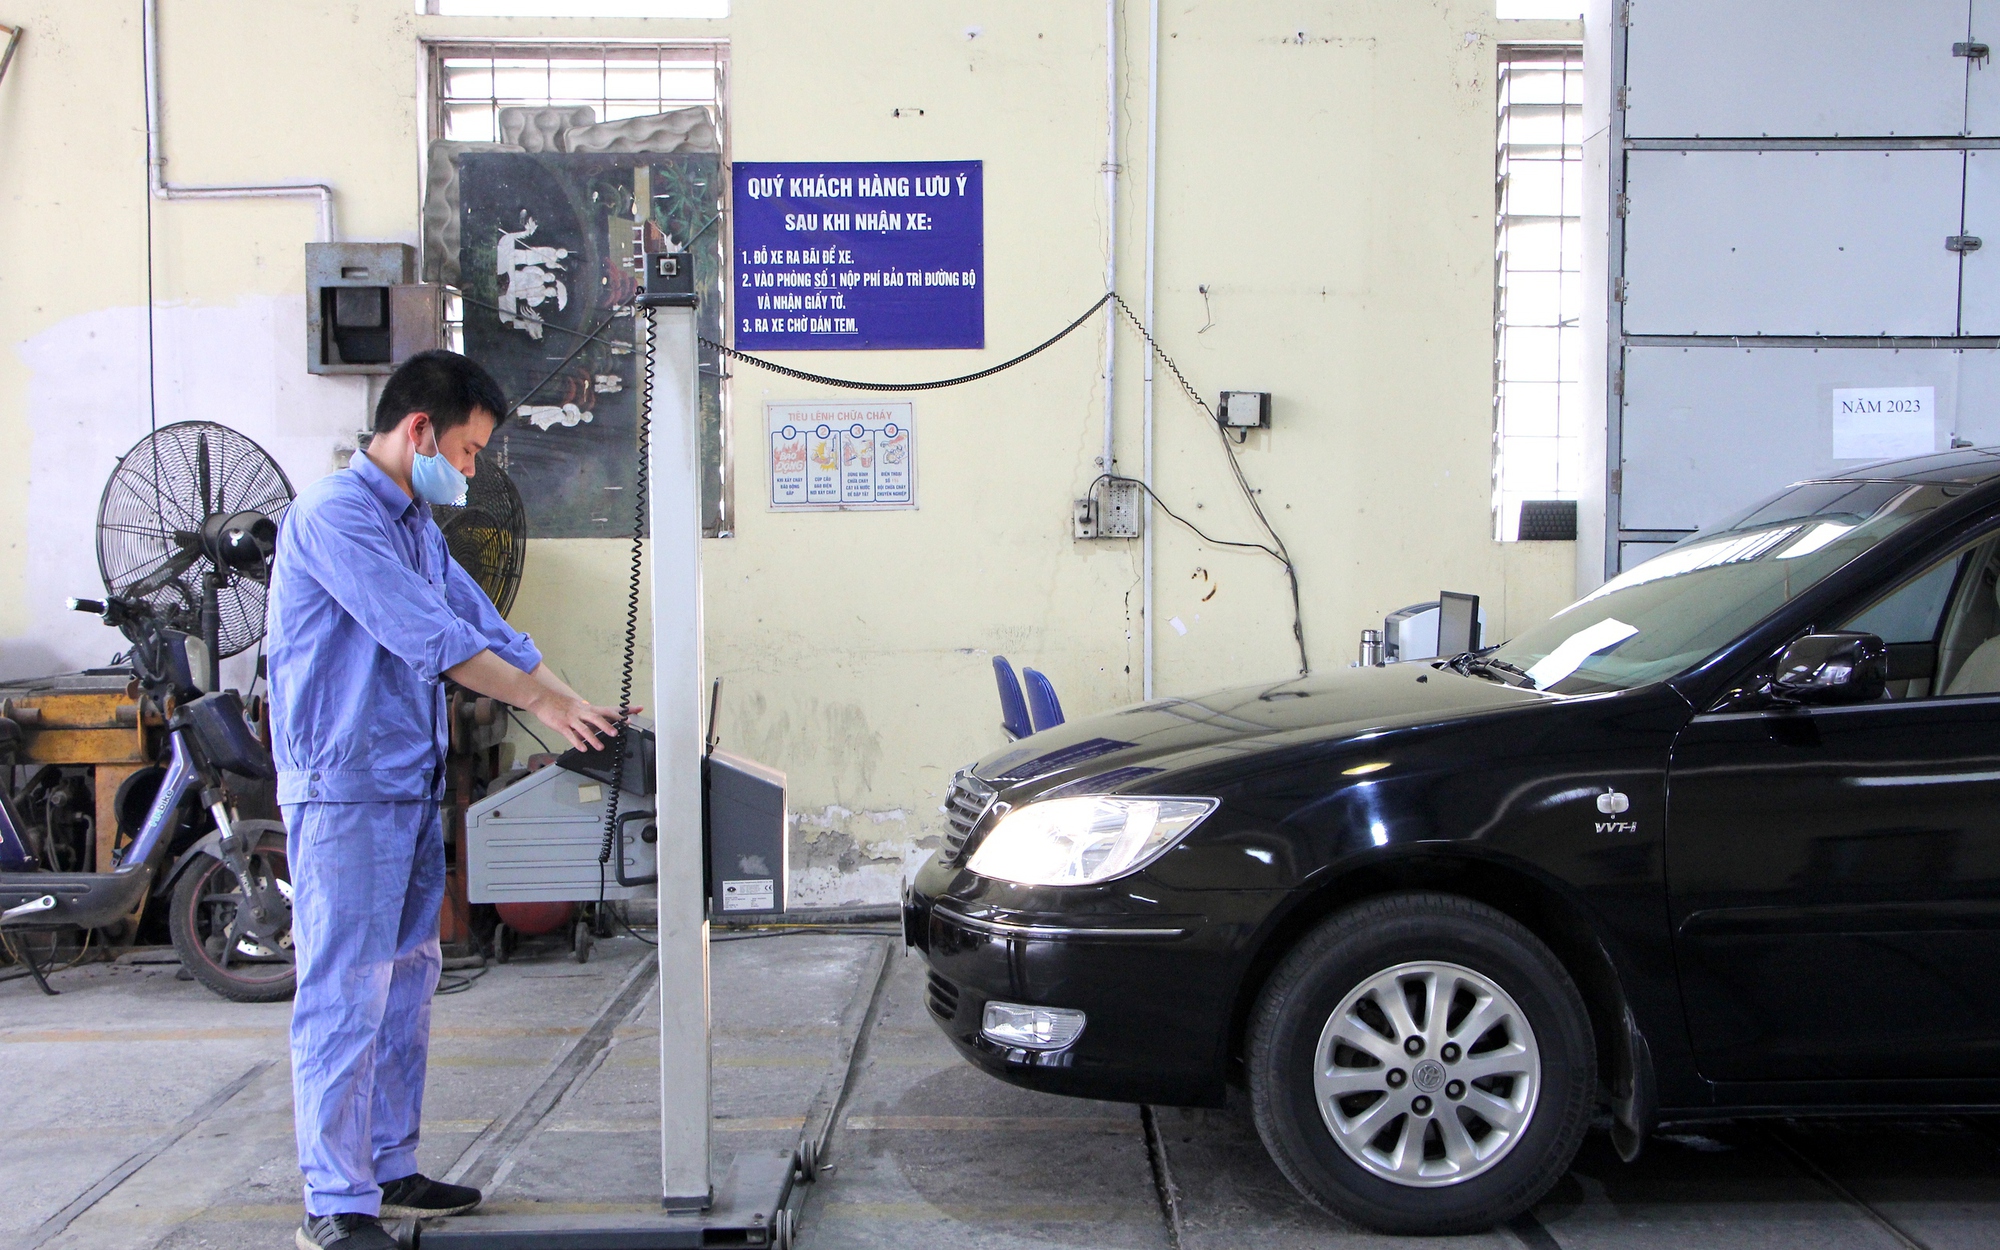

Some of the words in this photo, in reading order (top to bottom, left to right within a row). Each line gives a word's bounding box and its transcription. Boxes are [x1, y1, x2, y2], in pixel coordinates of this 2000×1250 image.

[748, 174, 784, 199] QUÝ
[790, 174, 852, 197] KHÁCH
[858, 174, 909, 197] HÀNG
[915, 175, 950, 197] LƯU
[955, 173, 967, 196] Ý
[785, 213, 817, 231] SAU
[823, 213, 850, 231] KHI
[855, 210, 901, 234] NHẬN
[906, 213, 932, 230] XE:
[742, 250, 751, 264] 1.
[754, 245, 768, 264] ĐỖ
[770, 250, 783, 264] XE
[786, 250, 800, 264] RA
[803, 247, 820, 264] BÃI
[822, 244, 836, 264] ĐỂ
[838, 250, 854, 264] XE.
[742, 273, 751, 287] 2.
[754, 270, 774, 287] VÀO
[777, 269, 811, 287] PHÒNG
[814, 268, 828, 287] SỐ
[831, 273, 836, 287] 1
[840, 269, 861, 290] NỘP
[863, 269, 880, 287] PHÍ
[883, 267, 904, 287] BẢO
[906, 269, 922, 286] TRÌ
[925, 268, 959, 286] ĐƯỜNG
[962, 268, 976, 289] BỘ
[757, 293, 771, 309] VÀ
[773, 293, 802, 313] NHẬN
[805, 290, 828, 309] GIẤY
[830, 292, 846, 309] TỜ.
[743, 318, 752, 333] 3.
[755, 318, 769, 332] RA
[772, 318, 784, 332] XE
[787, 315, 808, 333] CHỜ
[810, 315, 831, 332] DÁN
[834, 318, 859, 332] TEM.
[1842, 398, 1882, 414] NĂM
[1886, 399, 1921, 413] 2023
[788, 411, 808, 421] TIÊU
[810, 410, 835, 423] LỆNH
[837, 409, 864, 421] CHỮA
[866, 409, 893, 420] CHÁY
[786, 428, 792, 436] 1
[820, 428, 827, 436] 2
[854, 427, 861, 435] 3
[888, 426, 895, 434] 4
